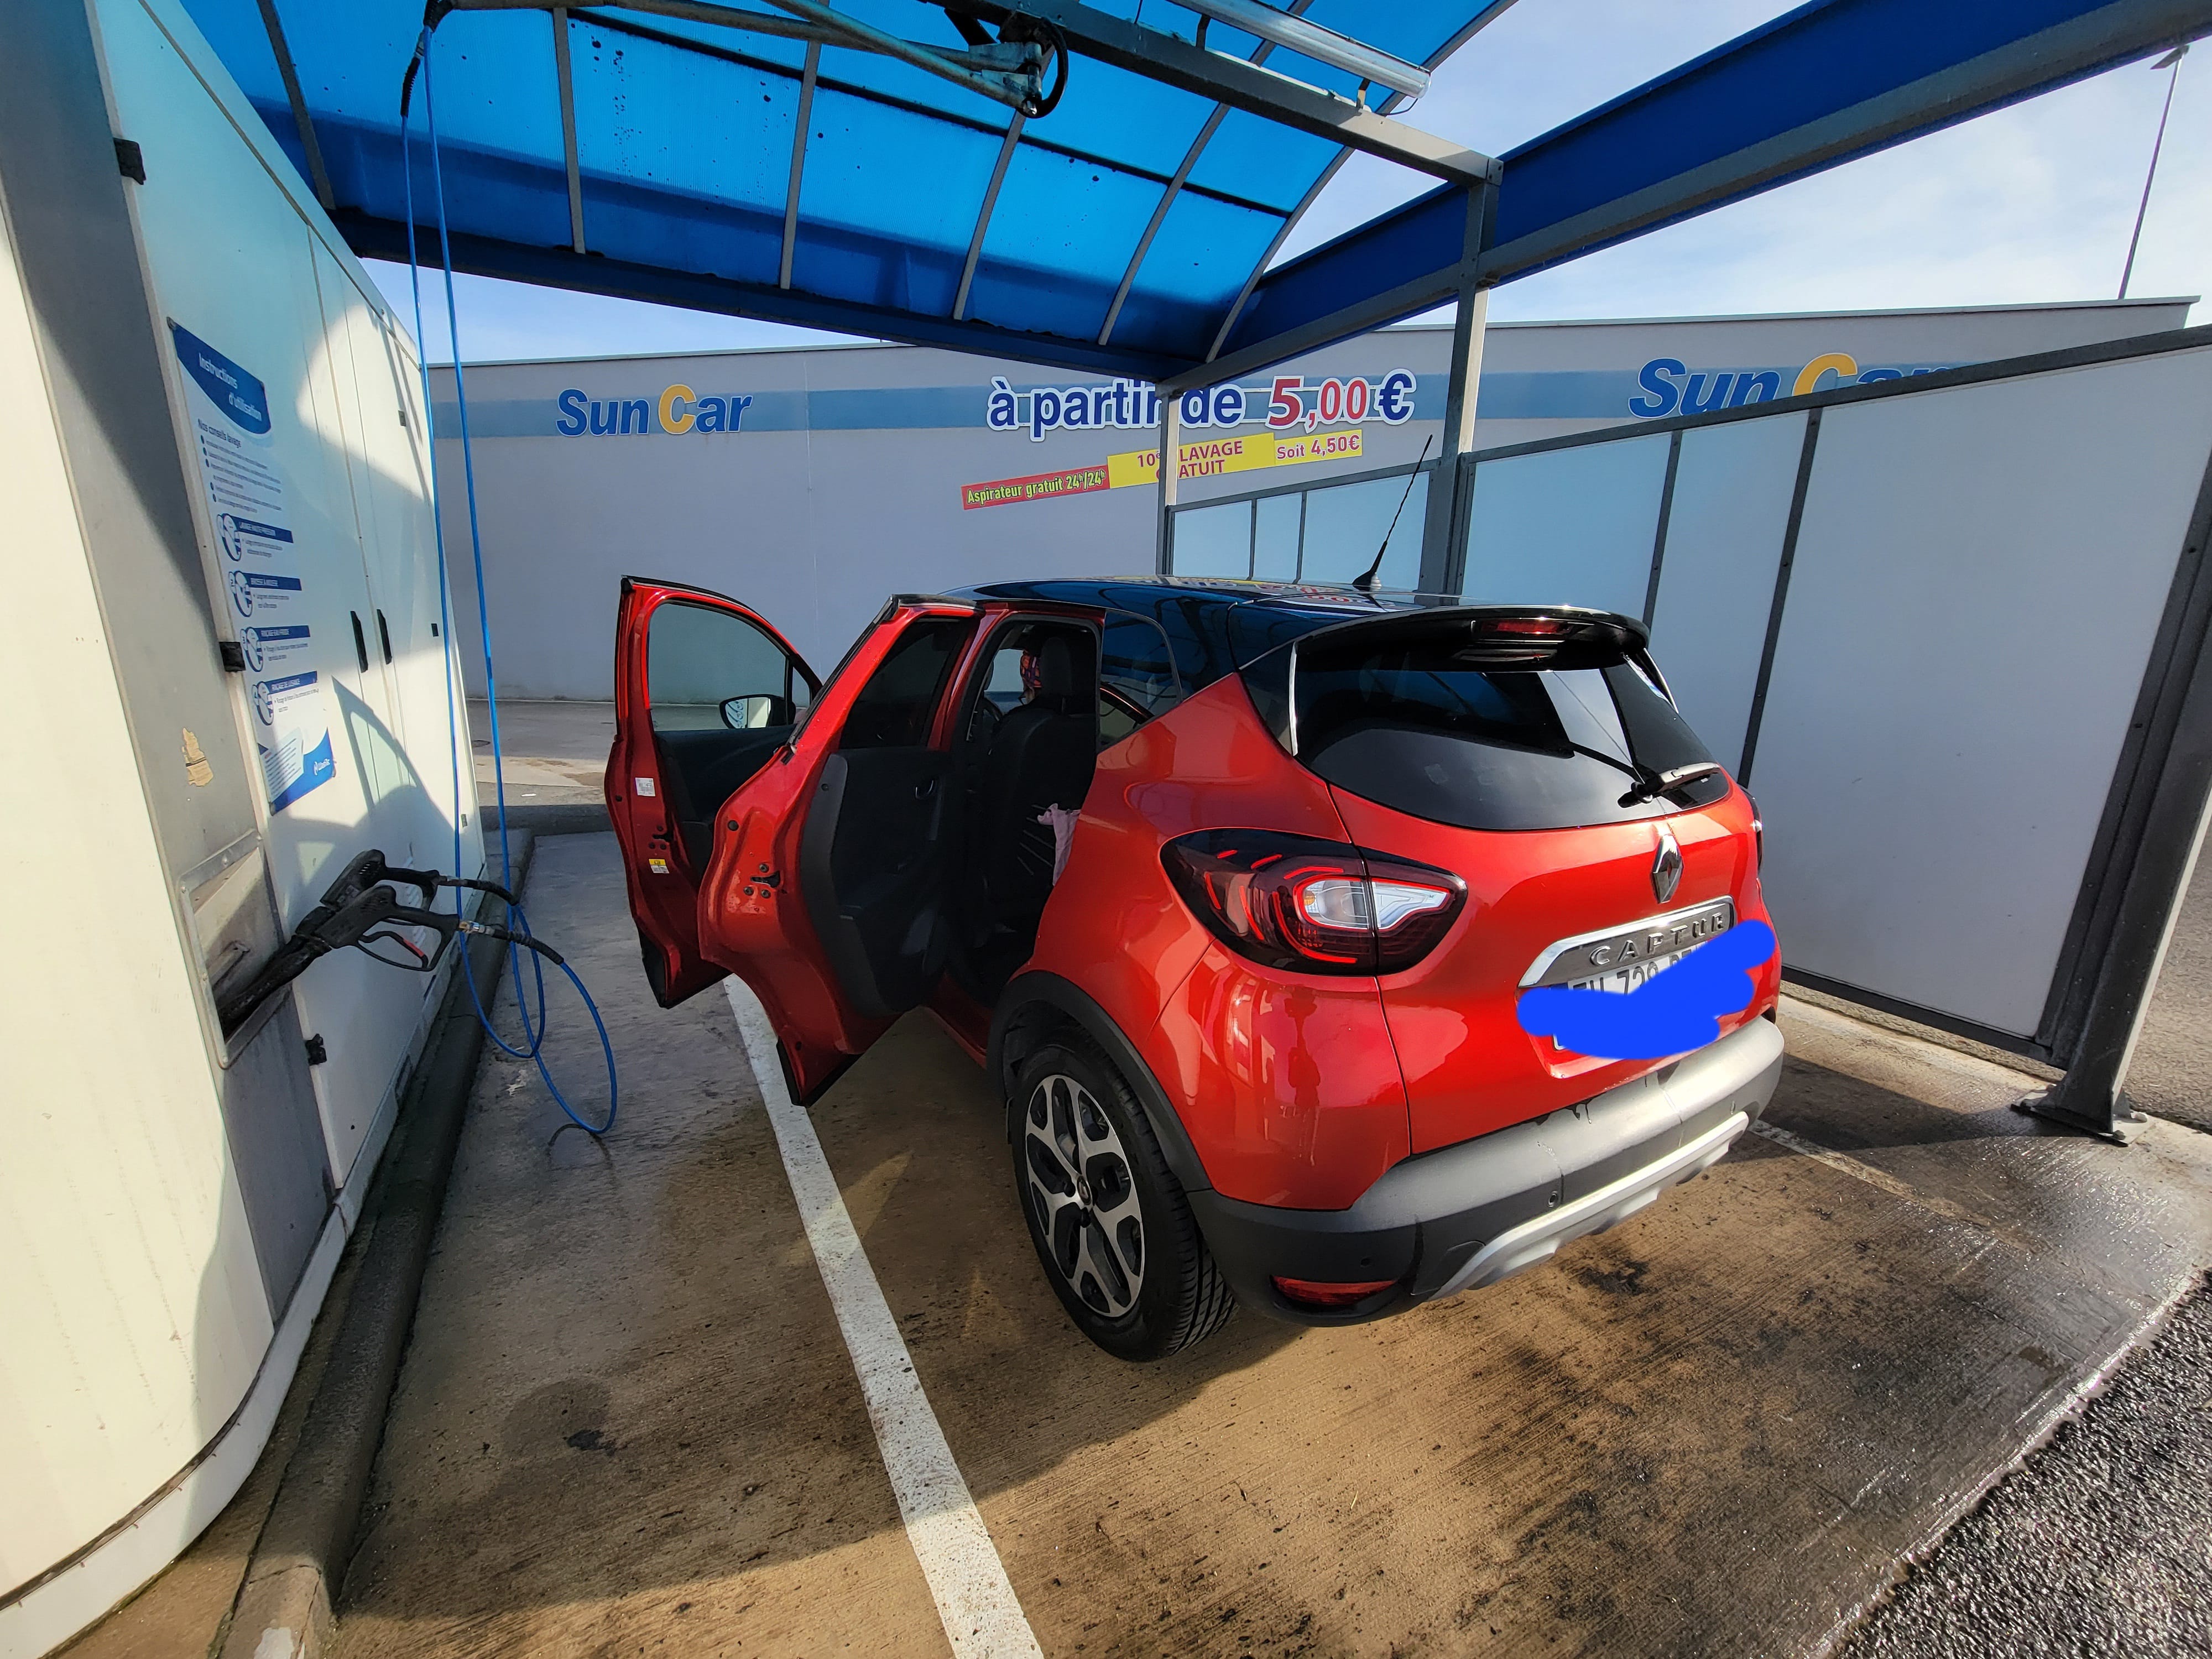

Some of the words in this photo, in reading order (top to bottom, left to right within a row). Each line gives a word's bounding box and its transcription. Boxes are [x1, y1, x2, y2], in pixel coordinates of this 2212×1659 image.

[990, 380, 1015, 426] à
[1181, 388, 1243, 425] de
[1179, 440, 1243, 462] LAVAGE
[1277, 445, 1305, 460] Soit
[1311, 434, 1360, 457] 4,50€
[967, 484, 1022, 506] Aspirateur
[1026, 478, 1063, 499] gratuit
[1589, 912, 1724, 966] CAPTUR
